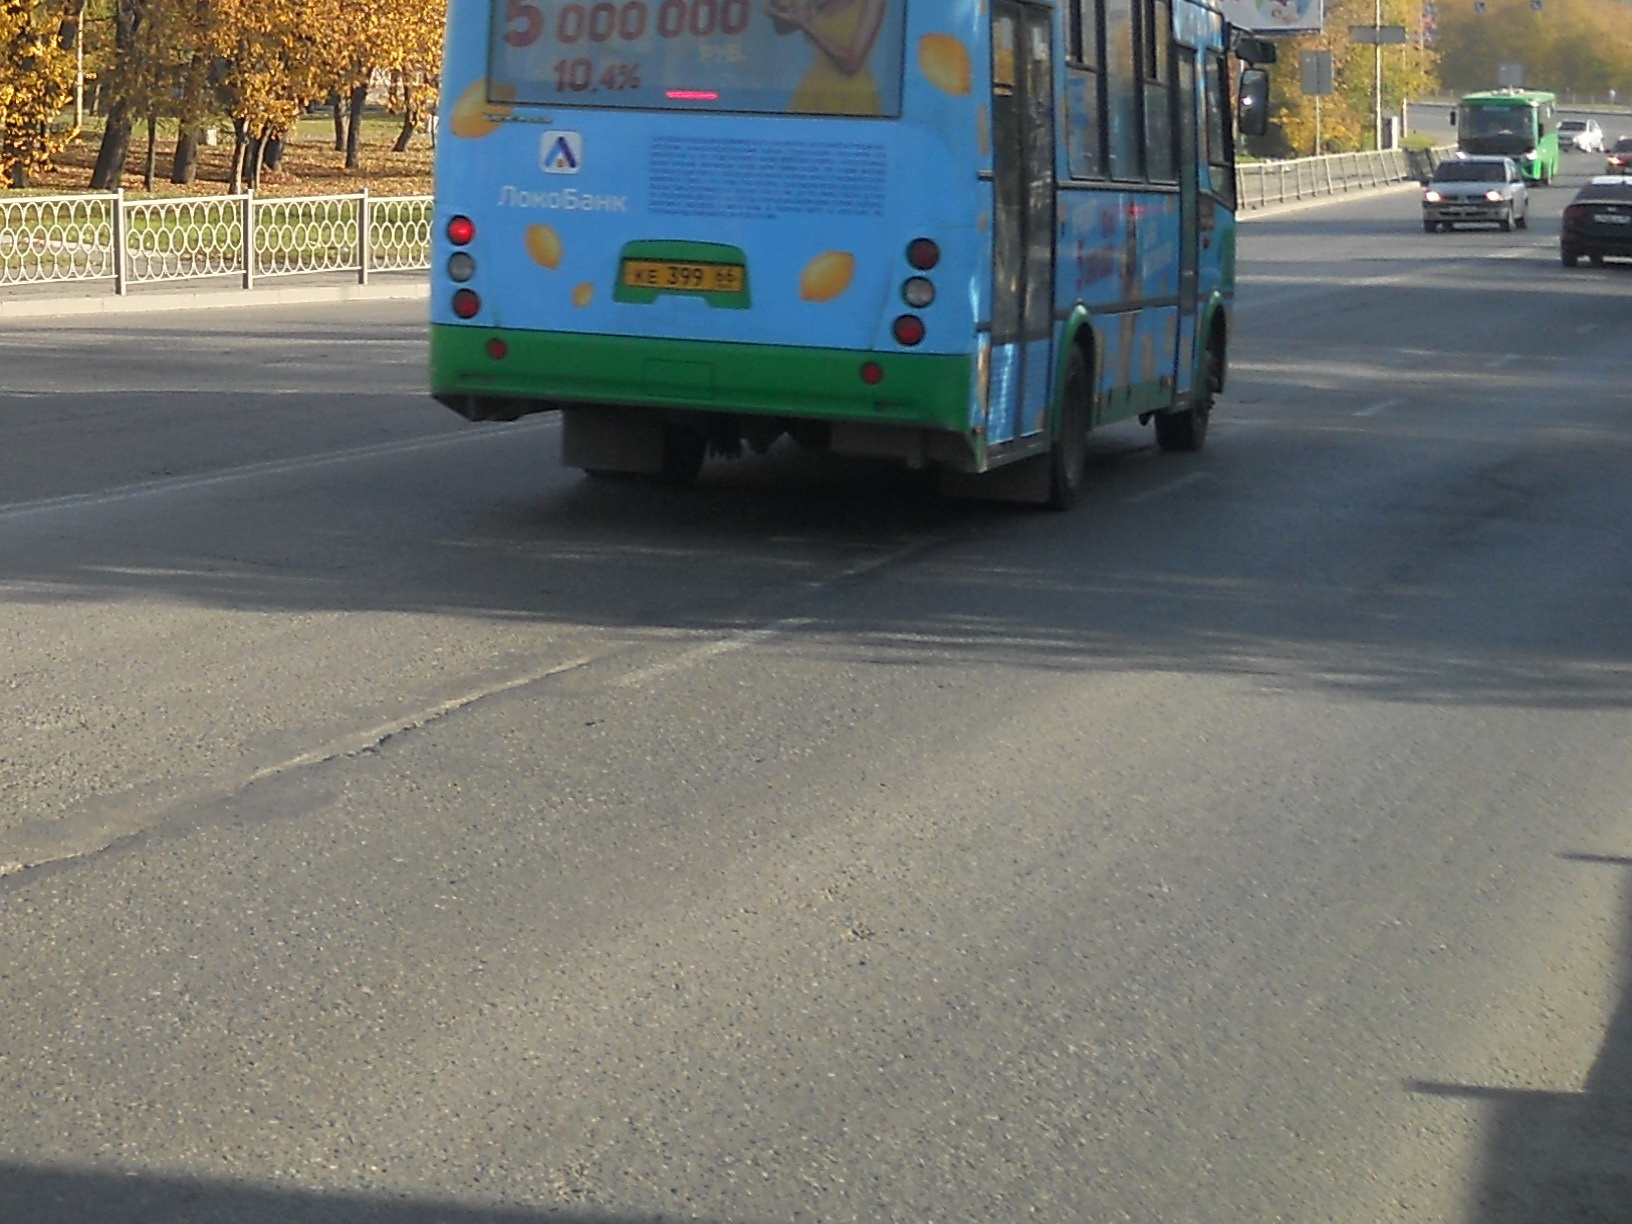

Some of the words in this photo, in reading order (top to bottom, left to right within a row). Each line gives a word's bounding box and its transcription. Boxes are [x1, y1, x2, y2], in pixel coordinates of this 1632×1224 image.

[556, 1, 648, 44] 000
[497, 185, 628, 212] ЛокоБанк
[667, 266, 703, 287] 399
